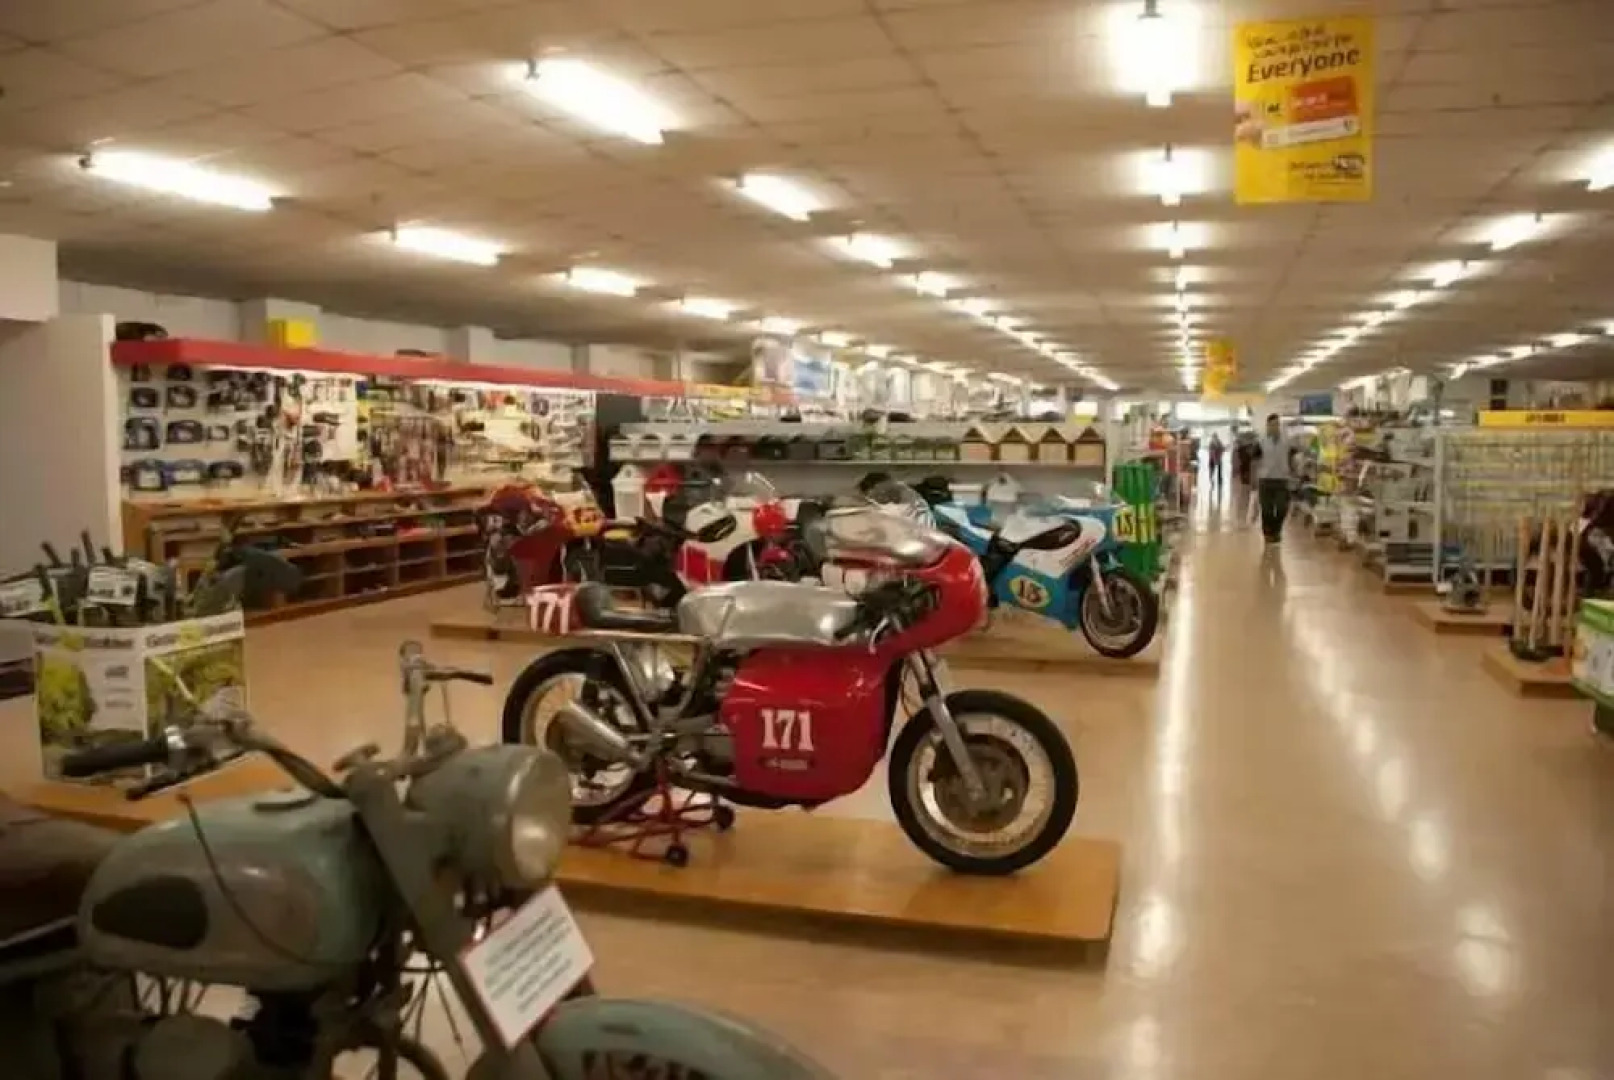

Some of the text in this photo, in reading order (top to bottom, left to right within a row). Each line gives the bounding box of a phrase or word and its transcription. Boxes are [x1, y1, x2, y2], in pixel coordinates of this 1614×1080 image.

[1246, 49, 1361, 84] Everyone
[526, 591, 571, 634] 171
[761, 708, 814, 751] 171
